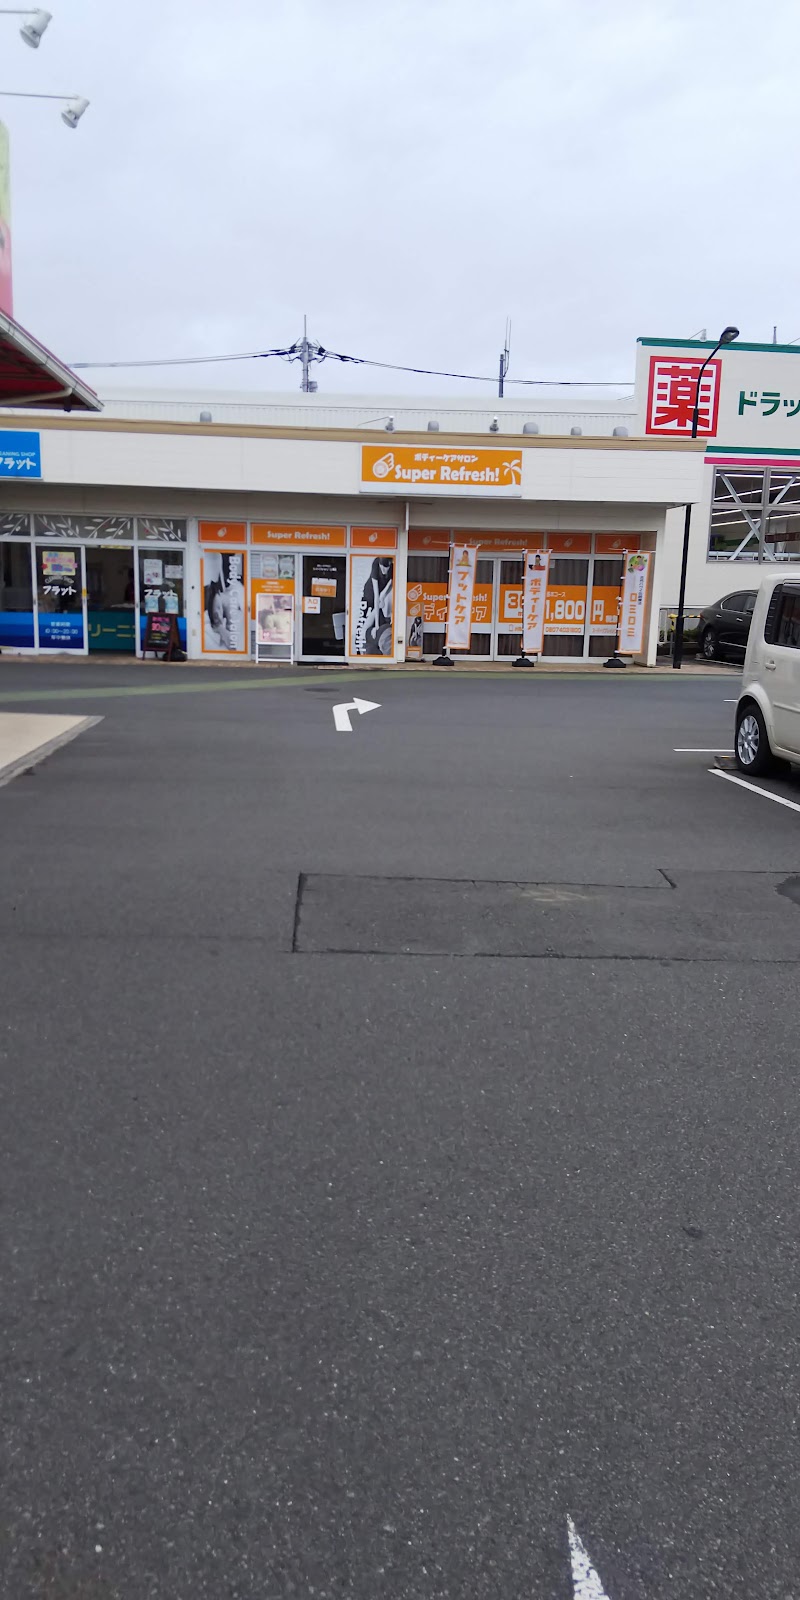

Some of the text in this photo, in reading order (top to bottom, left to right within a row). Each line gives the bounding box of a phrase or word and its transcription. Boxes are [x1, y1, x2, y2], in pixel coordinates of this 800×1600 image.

[653, 365, 714, 429] 薬
[738, 390, 800, 418] ドラッ
[414, 452, 478, 463] ボディーケアサロン
[394, 464, 500, 483] Super Refresh!
[267, 530, 330, 541] Super Refresh!
[227, 556, 241, 585] Body
[42, 585, 77, 596] フラット
[454, 571, 469, 625] フットケア
[527, 577, 542, 631] ボディーケア
[592, 599, 605, 622] 円
[627, 592, 638, 637] ロミロミ
